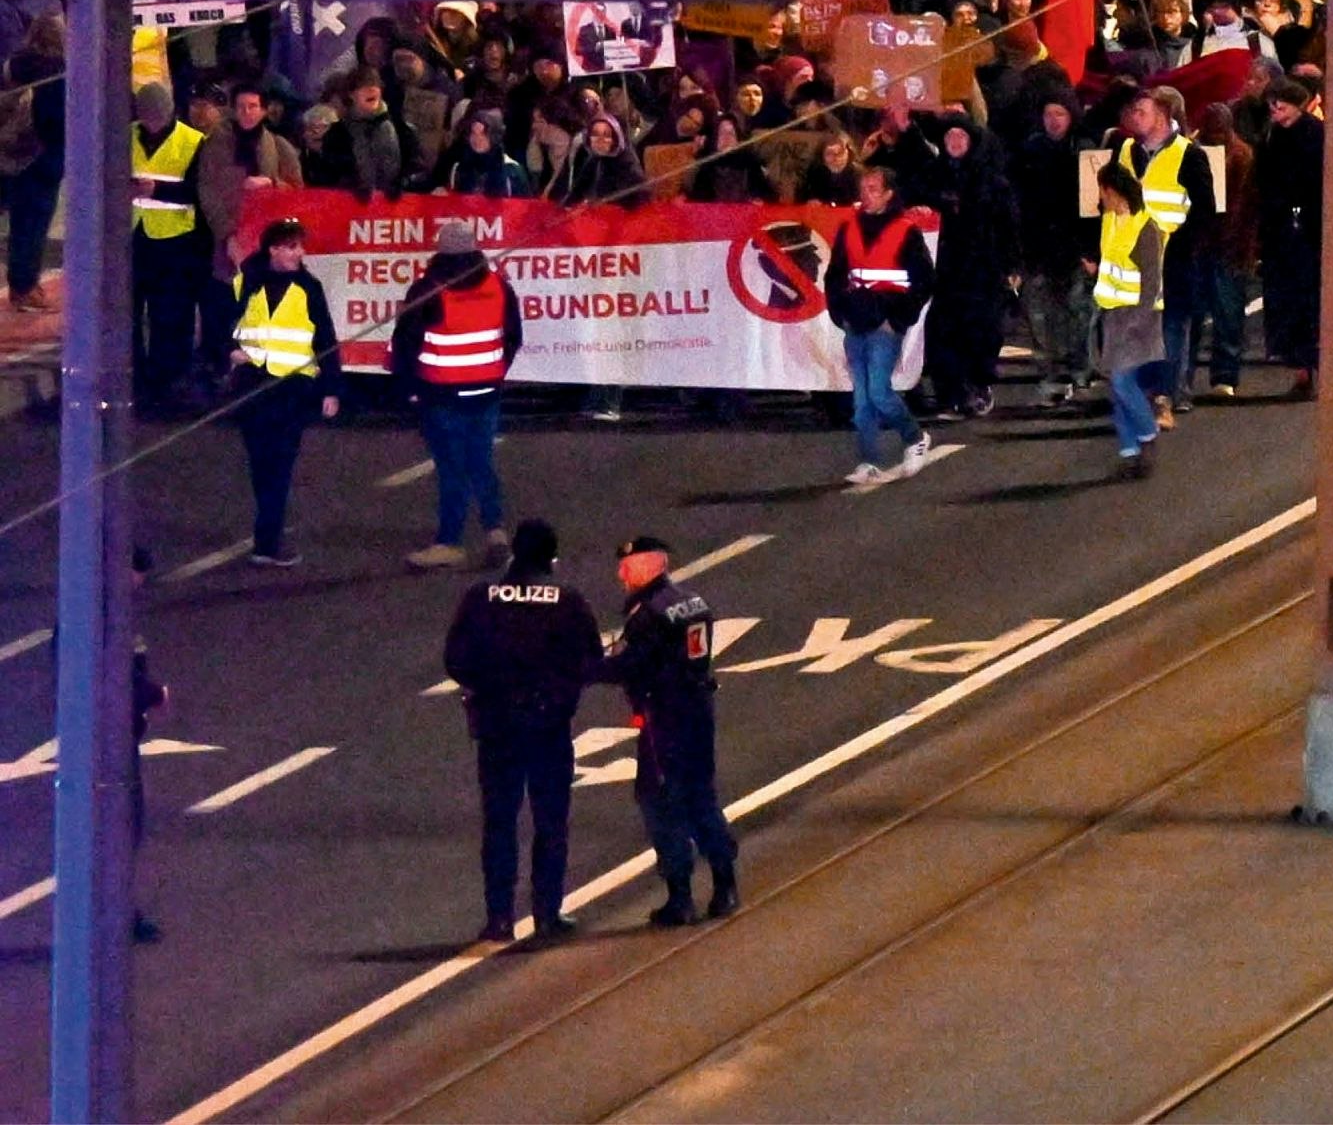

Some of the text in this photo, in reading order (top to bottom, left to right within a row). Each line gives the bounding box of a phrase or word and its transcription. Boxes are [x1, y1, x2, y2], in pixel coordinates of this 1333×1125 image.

[350, 218, 423, 245] NEIN
[346, 251, 641, 285] RECHXTREMEN
[346, 289, 710, 324] BUBUNDBALL!
[488, 584, 561, 604] POLIZEI
